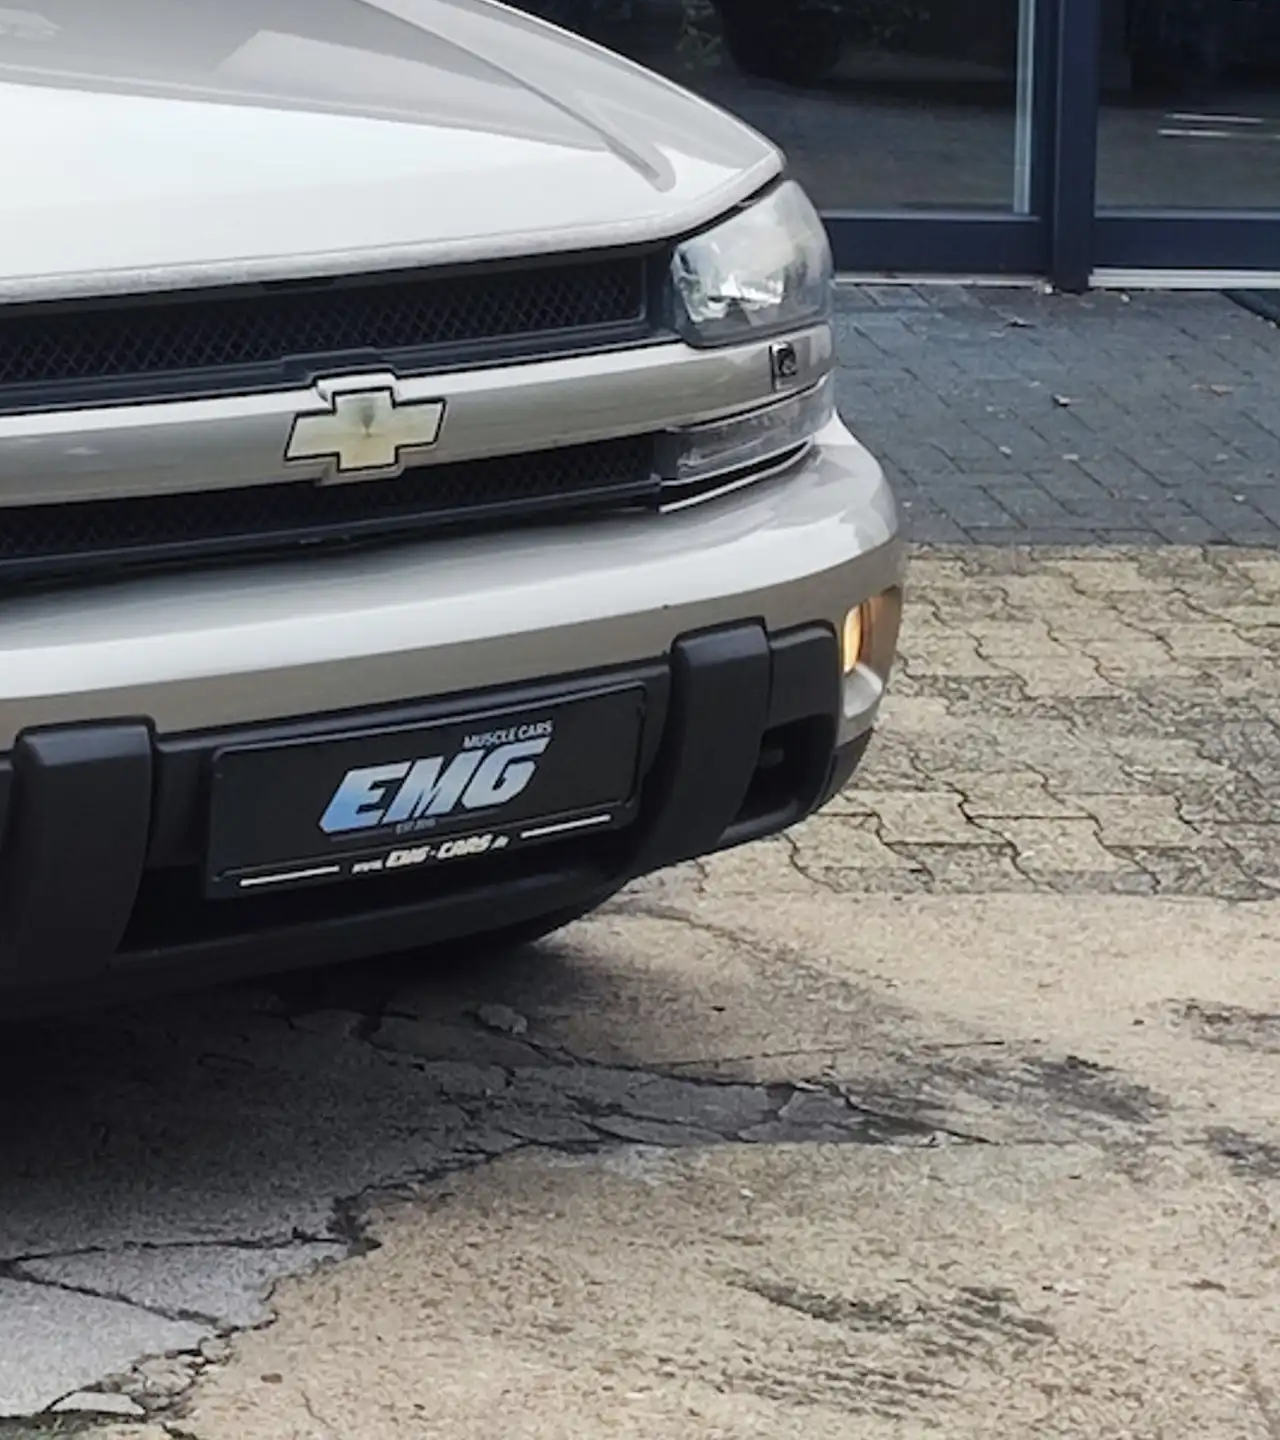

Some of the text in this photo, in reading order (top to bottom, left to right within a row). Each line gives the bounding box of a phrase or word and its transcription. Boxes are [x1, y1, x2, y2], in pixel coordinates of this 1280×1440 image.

[462, 719, 554, 749] MUSCLE CARS
[318, 736, 551, 835] EMG
